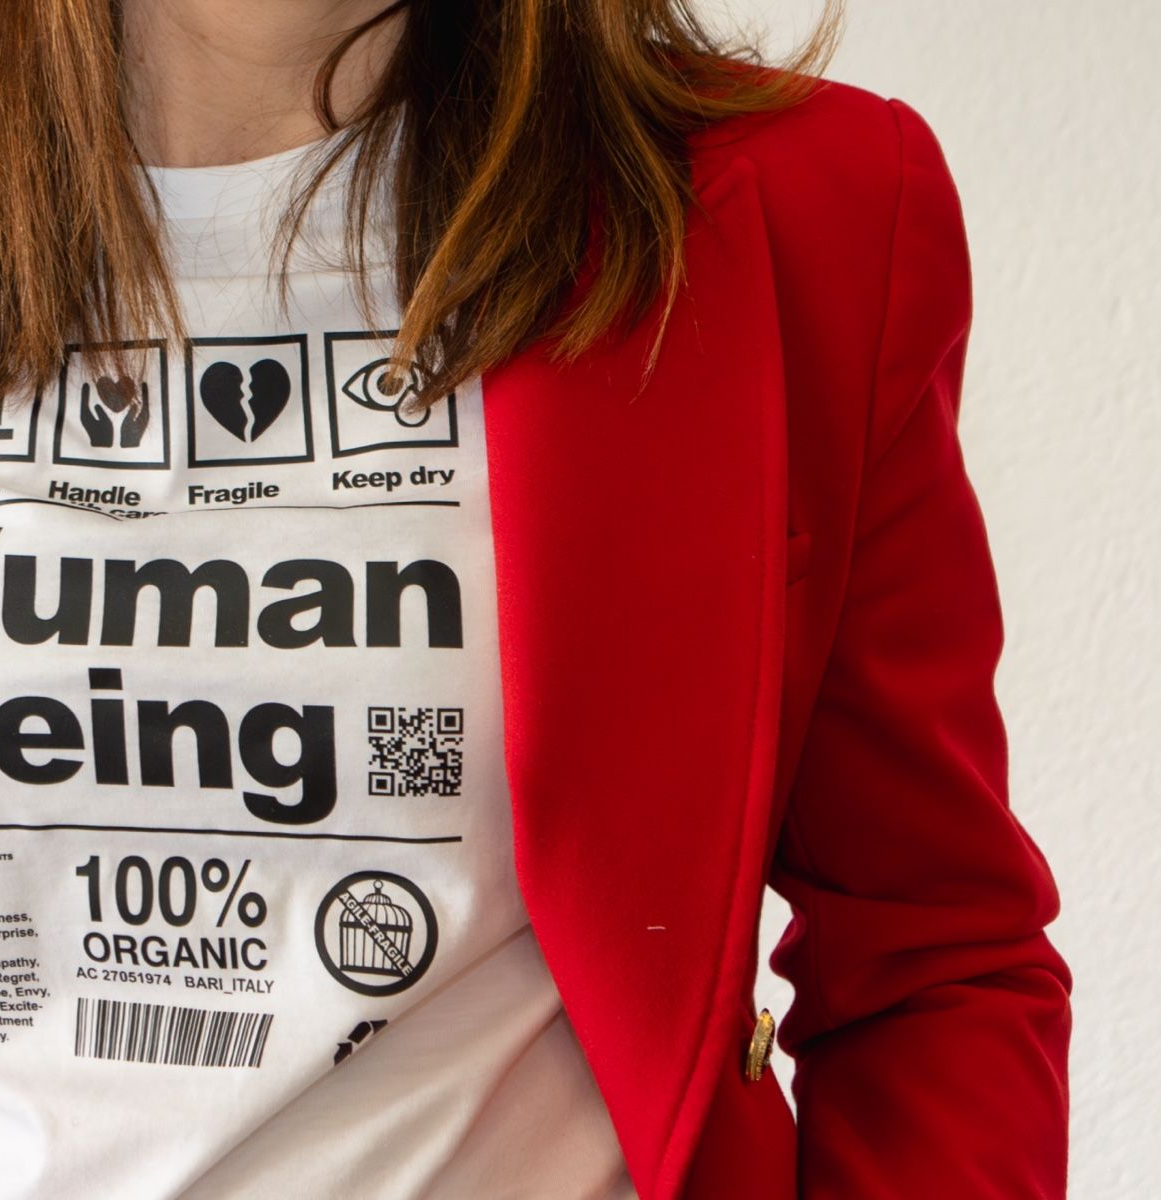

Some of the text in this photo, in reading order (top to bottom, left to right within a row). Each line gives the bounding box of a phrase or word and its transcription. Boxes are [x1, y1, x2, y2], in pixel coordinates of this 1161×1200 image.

[332, 466, 455, 491] Keep dry
[48, 481, 141, 506] Handle
[188, 482, 280, 504] Fragile
[75, 855, 268, 928] 100%
[339, 892, 413, 977] AGILE-FRAGILE
[83, 932, 268, 971] ORGANIC
[15, 987, 50, 998] Envy,
[76, 967, 275, 995] AC 27051974 BARI_ITALY
[0, 1001, 43, 1011] Excite-
